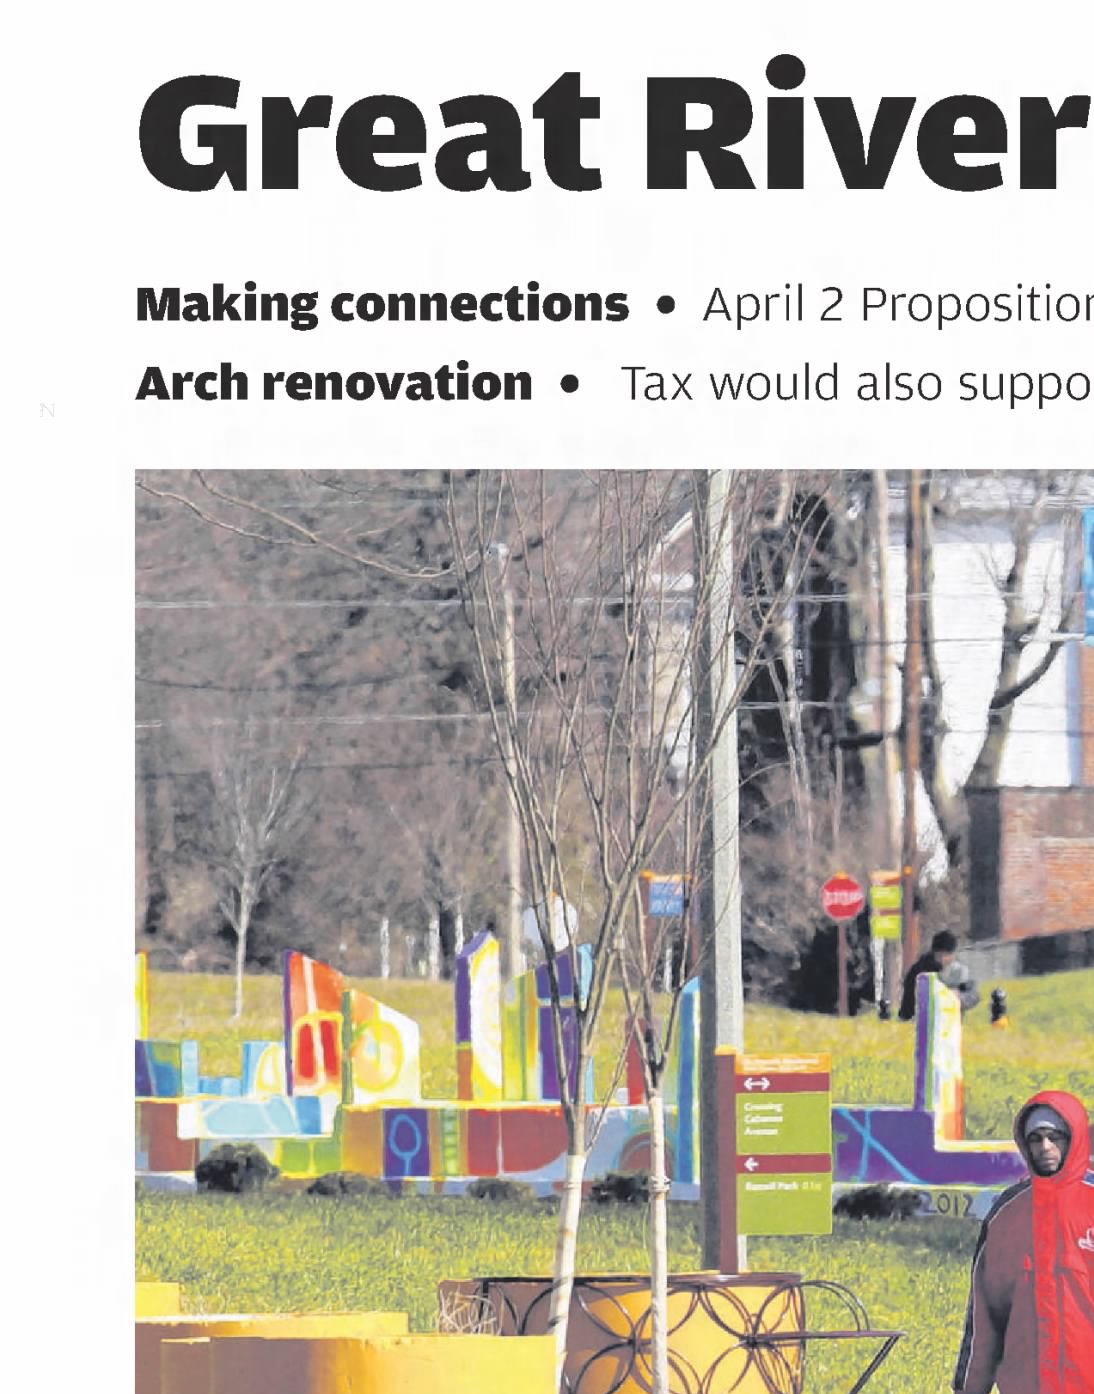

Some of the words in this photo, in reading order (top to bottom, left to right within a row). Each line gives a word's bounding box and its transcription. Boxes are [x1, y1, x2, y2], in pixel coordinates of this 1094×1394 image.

[138, 71, 603, 193] Great
[136, 280, 319, 332] Making
[330, 280, 630, 322] connections
[702, 282, 803, 331] April
[820, 286, 843, 322] 2
[134, 361, 249, 401] Arch
[263, 359, 532, 402] renovation
[620, 366, 693, 401] Tax
[709, 361, 838, 401] would
[857, 361, 942, 402] also
[921, 1191, 976, 1217] 2012
